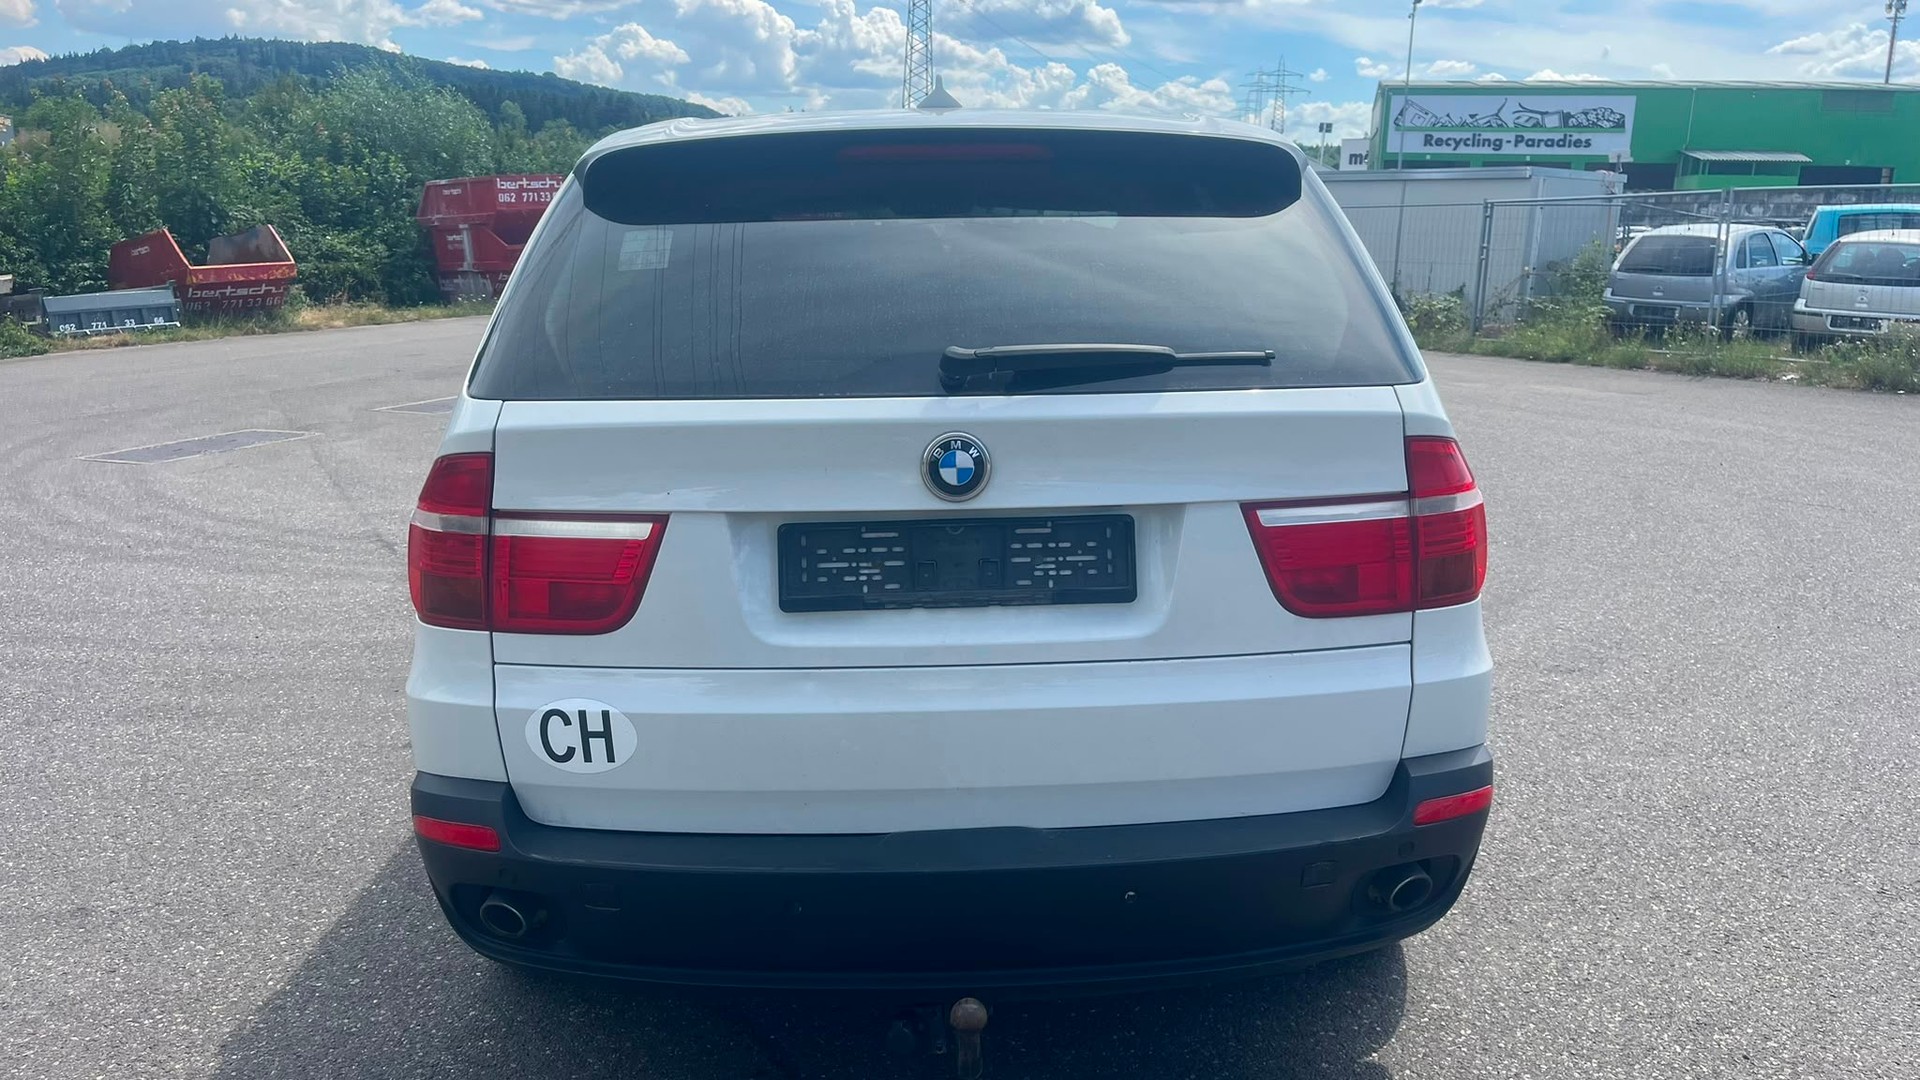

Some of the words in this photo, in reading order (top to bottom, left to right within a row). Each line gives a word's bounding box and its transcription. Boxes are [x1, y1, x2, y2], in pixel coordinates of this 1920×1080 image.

[498, 192, 516, 203] 062
[933, 440, 980, 459] BMW
[540, 708, 616, 763] CH
